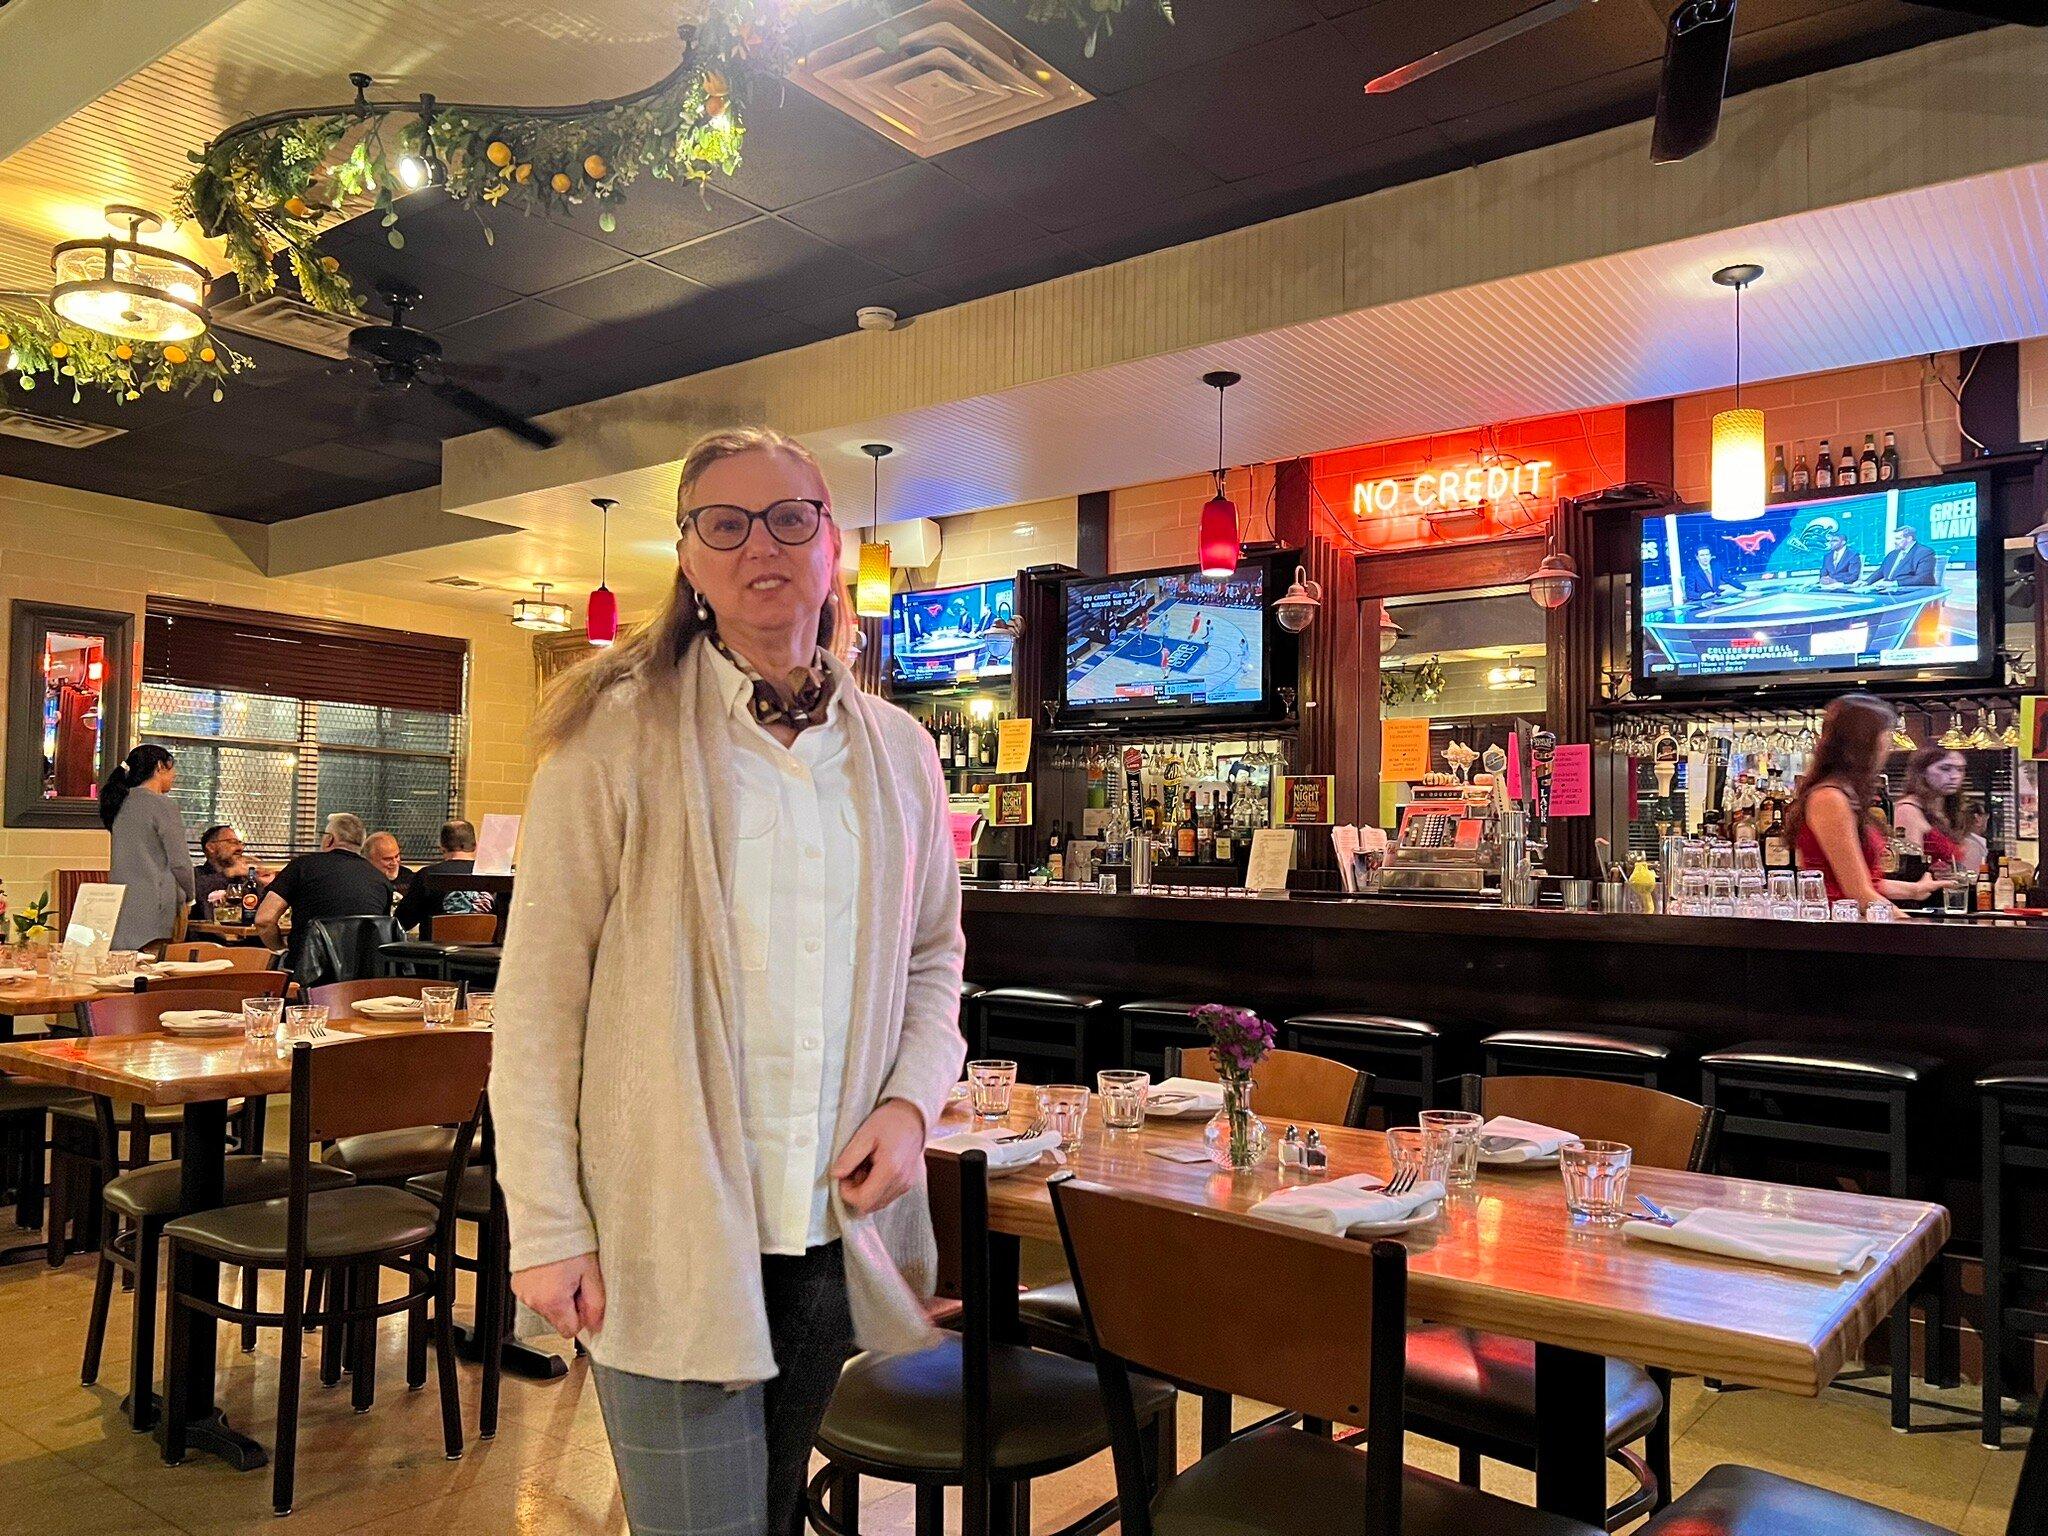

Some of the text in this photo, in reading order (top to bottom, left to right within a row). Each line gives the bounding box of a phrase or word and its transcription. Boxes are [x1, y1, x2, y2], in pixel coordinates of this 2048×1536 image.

[1353, 460, 1552, 515] NO CREDIT
[1707, 644, 1791, 655] COLLEGE FOOTBALL
[1294, 791, 1320, 802] NIGHT
[1540, 788, 1548, 823] LAGER
